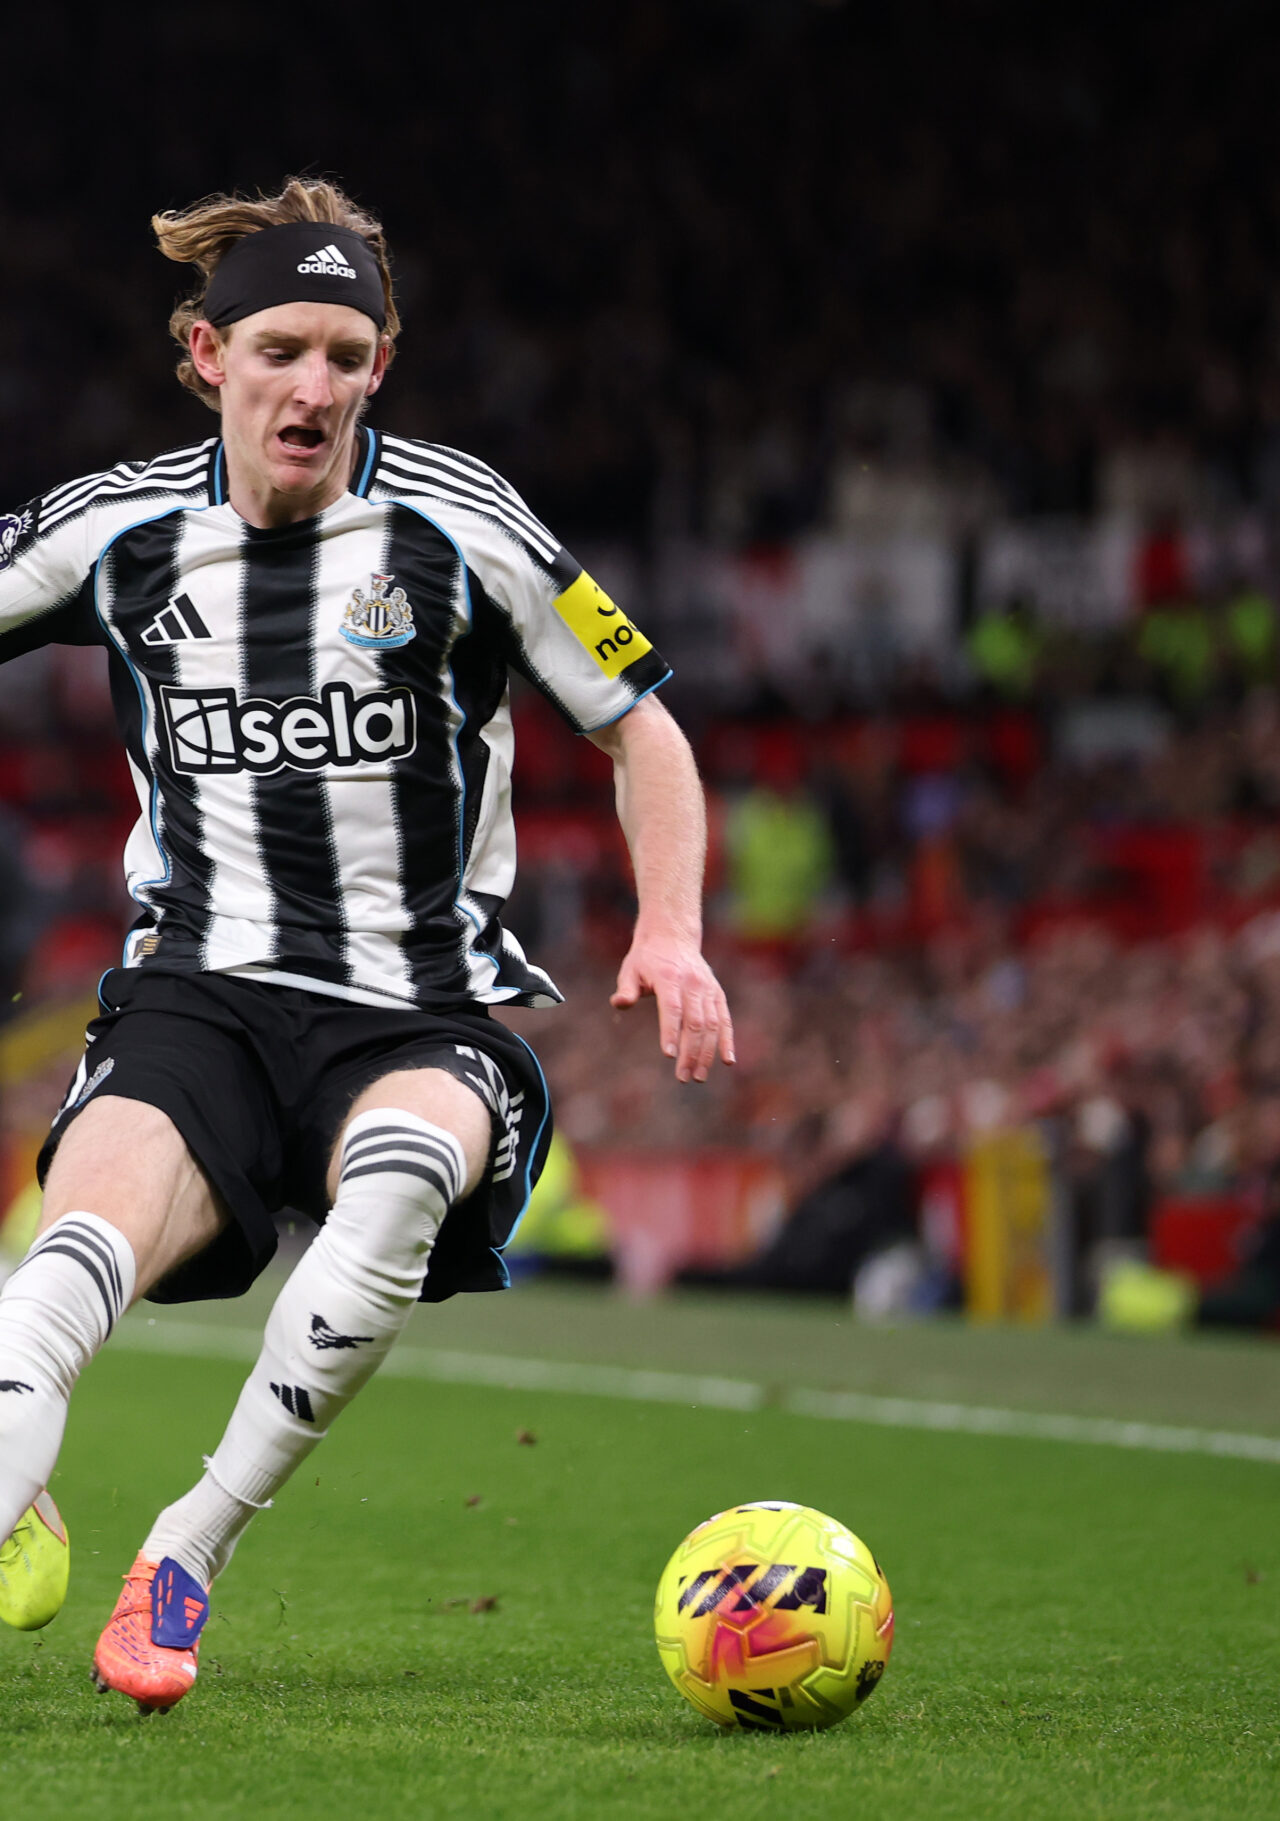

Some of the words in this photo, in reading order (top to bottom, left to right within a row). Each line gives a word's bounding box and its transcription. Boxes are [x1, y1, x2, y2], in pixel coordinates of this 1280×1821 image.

[297, 261, 357, 279] adidas
[594, 617, 641, 662] no
[239, 690, 406, 765] sela
